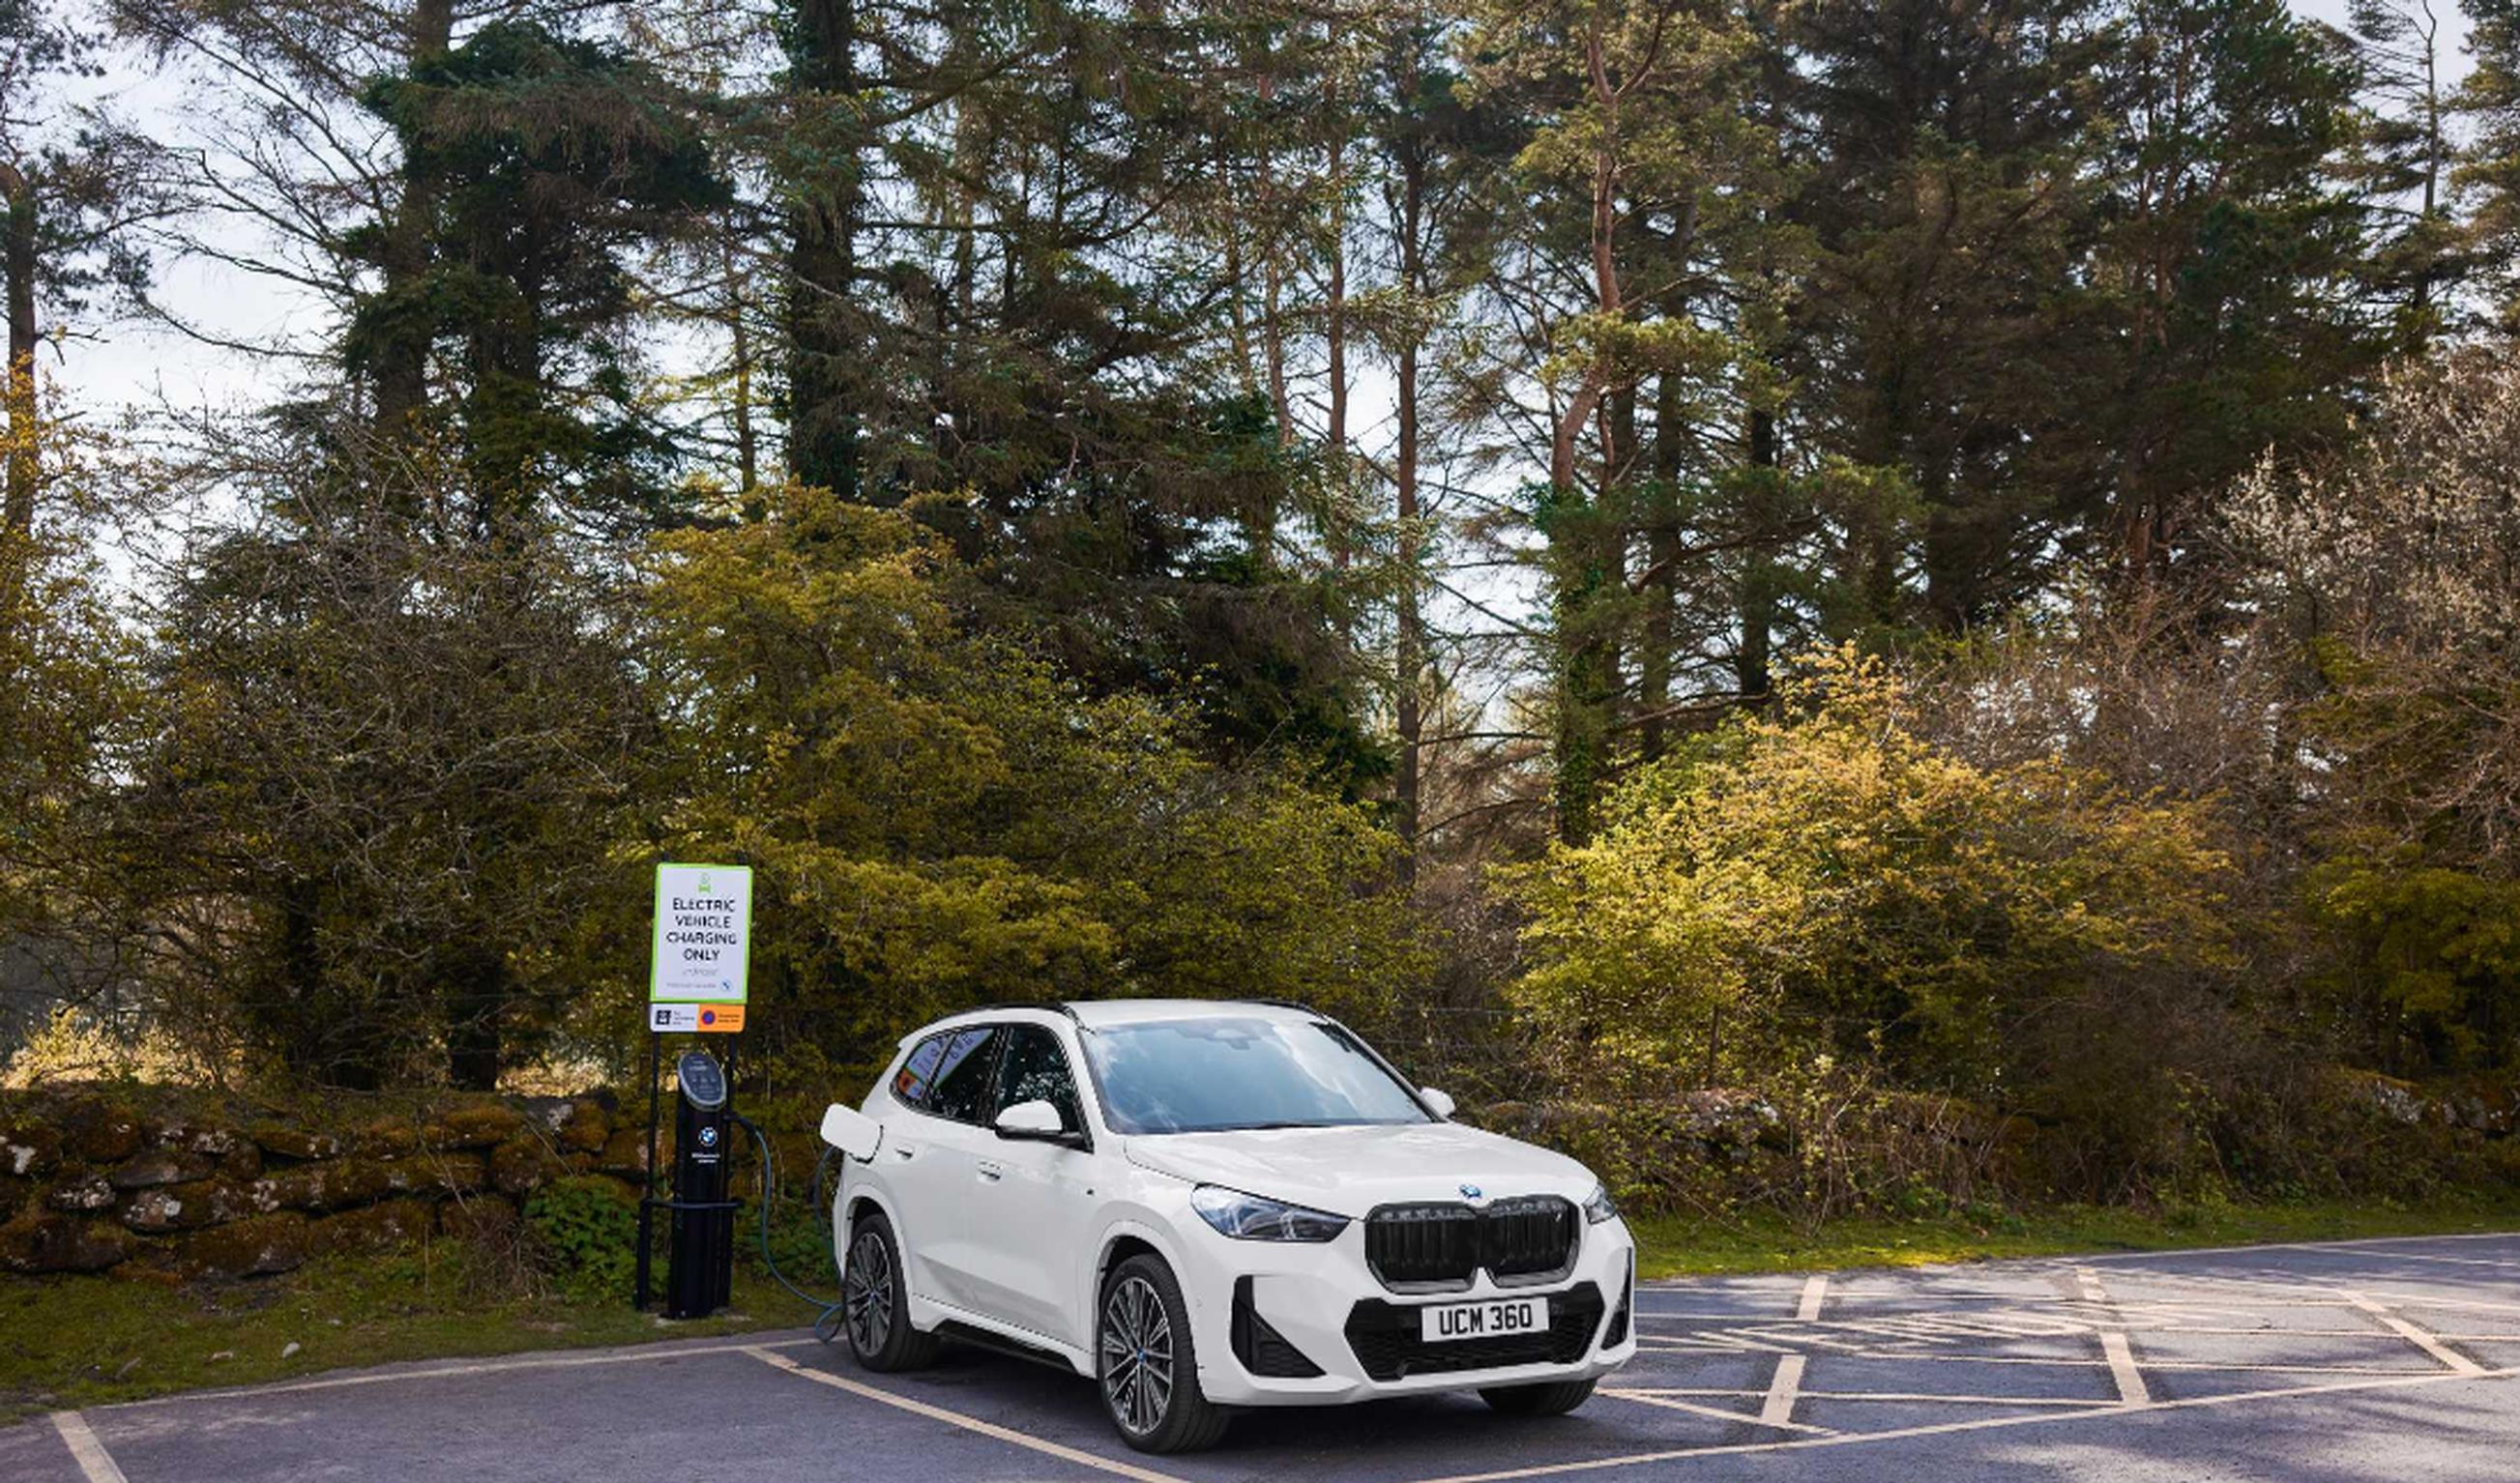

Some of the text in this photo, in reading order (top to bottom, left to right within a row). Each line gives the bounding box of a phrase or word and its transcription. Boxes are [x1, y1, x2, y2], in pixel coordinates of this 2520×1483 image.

[673, 897, 736, 913] ELECTRIC
[675, 915, 731, 928] VEHICLE
[666, 932, 737, 945] CHARGING
[683, 947, 721, 962] ONLY
[1439, 1303, 1532, 1335] UCM 360
